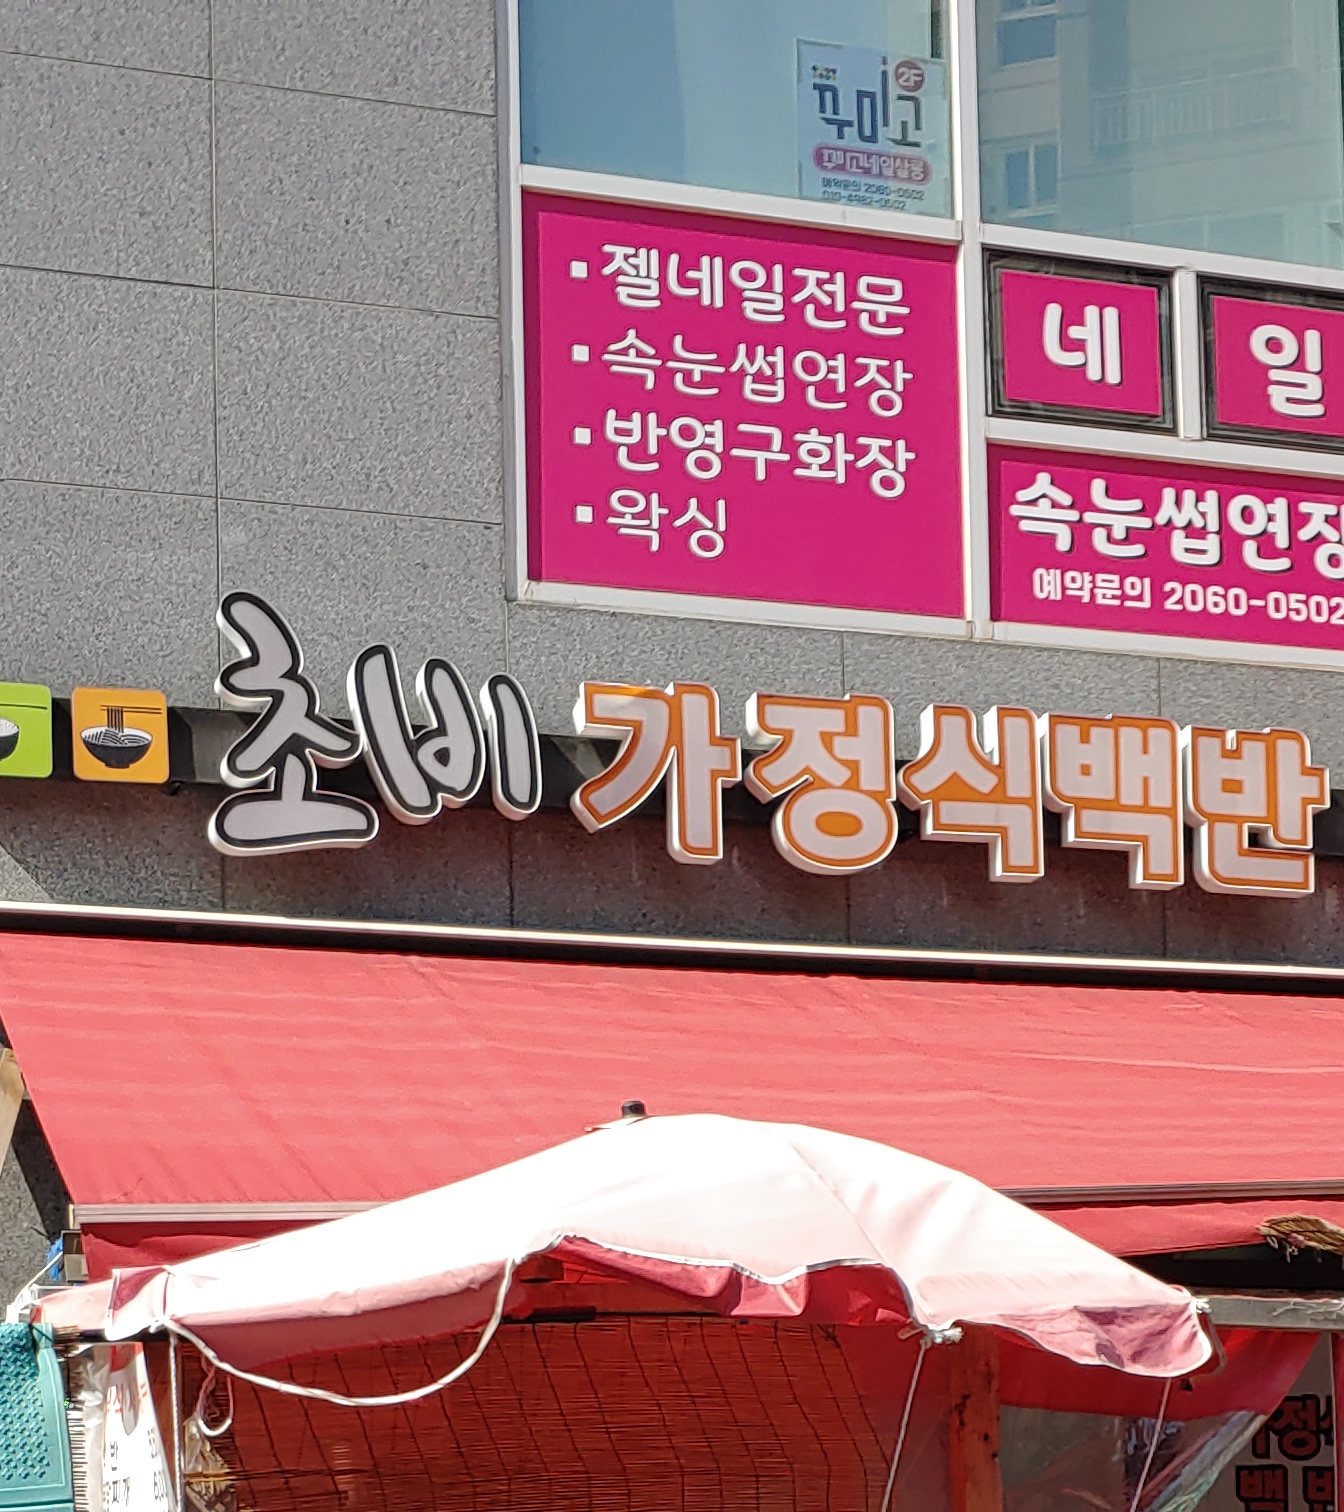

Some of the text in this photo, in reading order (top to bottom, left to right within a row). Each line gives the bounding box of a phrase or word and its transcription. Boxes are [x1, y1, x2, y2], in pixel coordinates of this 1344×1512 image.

[897, 66, 924, 88] 2F
[601, 244, 911, 336] 젤네일전문
[601, 328, 913, 419] 속눈썹연장
[604, 409, 915, 499] 반영구화장
[606, 487, 728, 559] 왁싱
[1032, 567, 1151, 610] 예약문의
[207, 589, 543, 857] 초비
[570, 680, 1331, 897] 가정식백반
